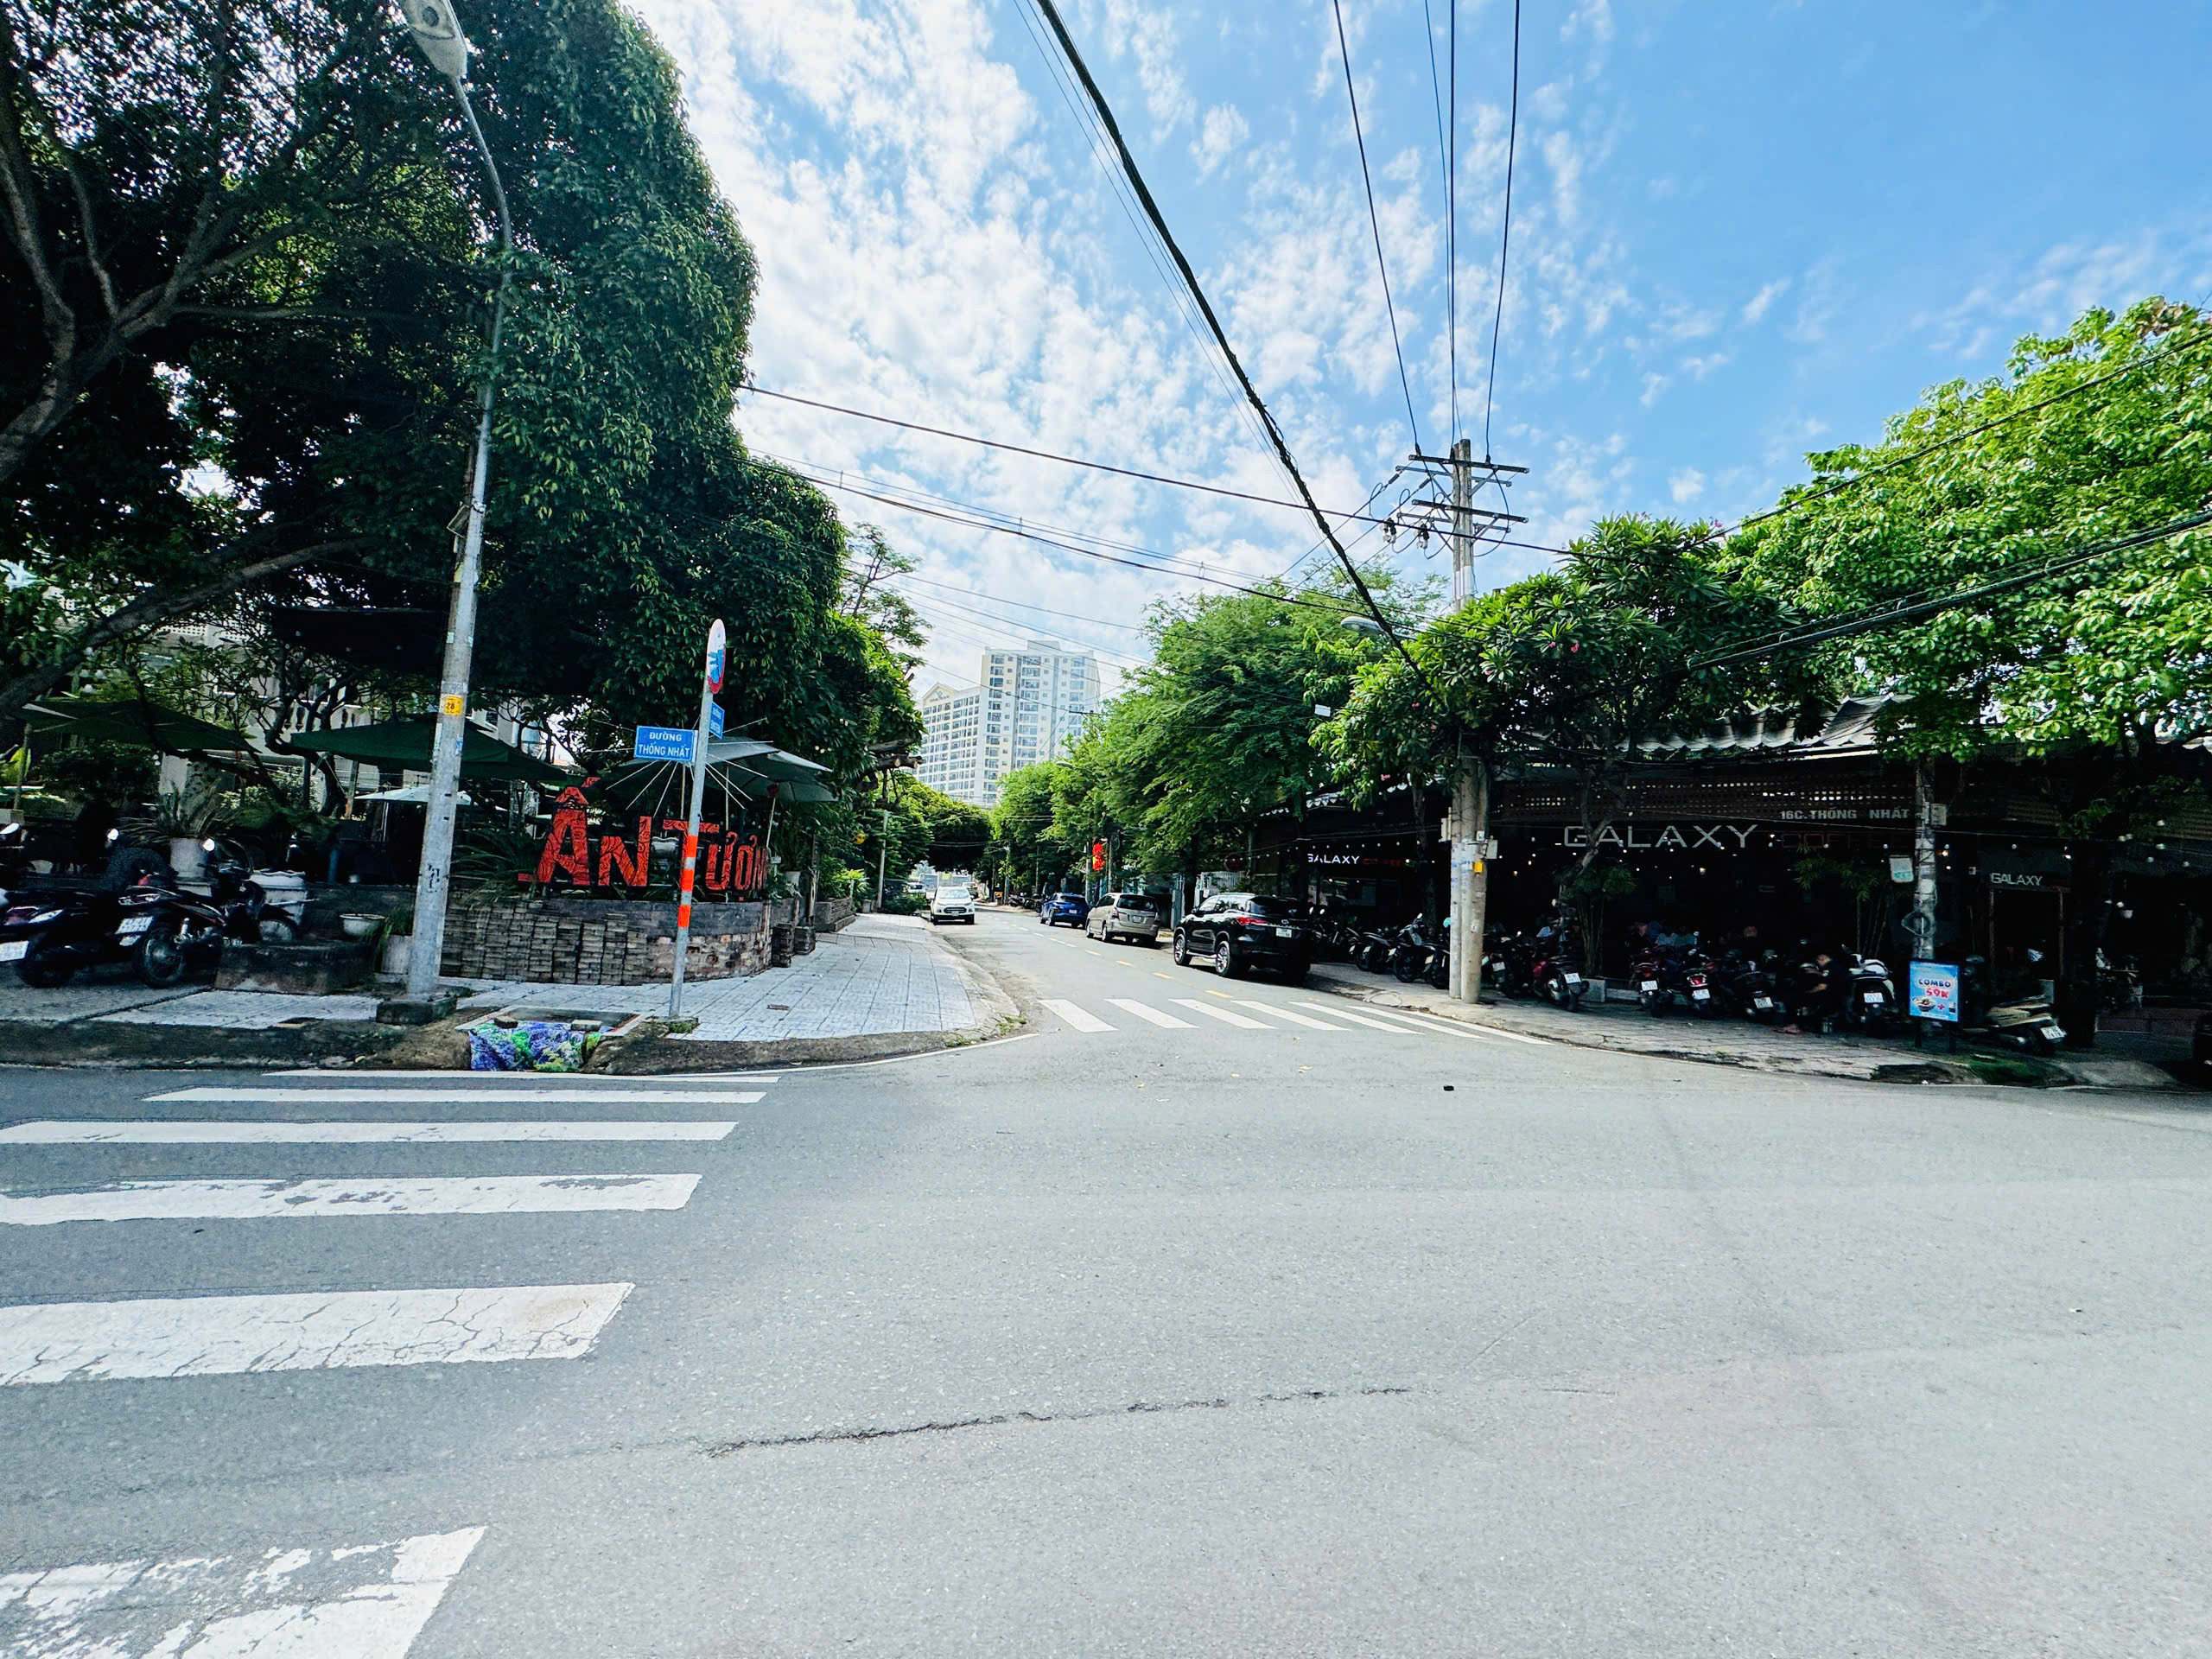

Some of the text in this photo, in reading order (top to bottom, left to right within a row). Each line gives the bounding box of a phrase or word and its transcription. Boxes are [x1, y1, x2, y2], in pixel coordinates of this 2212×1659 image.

[649, 732, 683, 742] ĐƯỜNG
[638, 741, 690, 758] THỐNG NHẤT
[1563, 824, 1758, 850] GALAXY
[1307, 853, 1360, 864] GALAXY
[1990, 873, 2044, 887] GALAXY
[1918, 978, 1951, 988] COMBO
